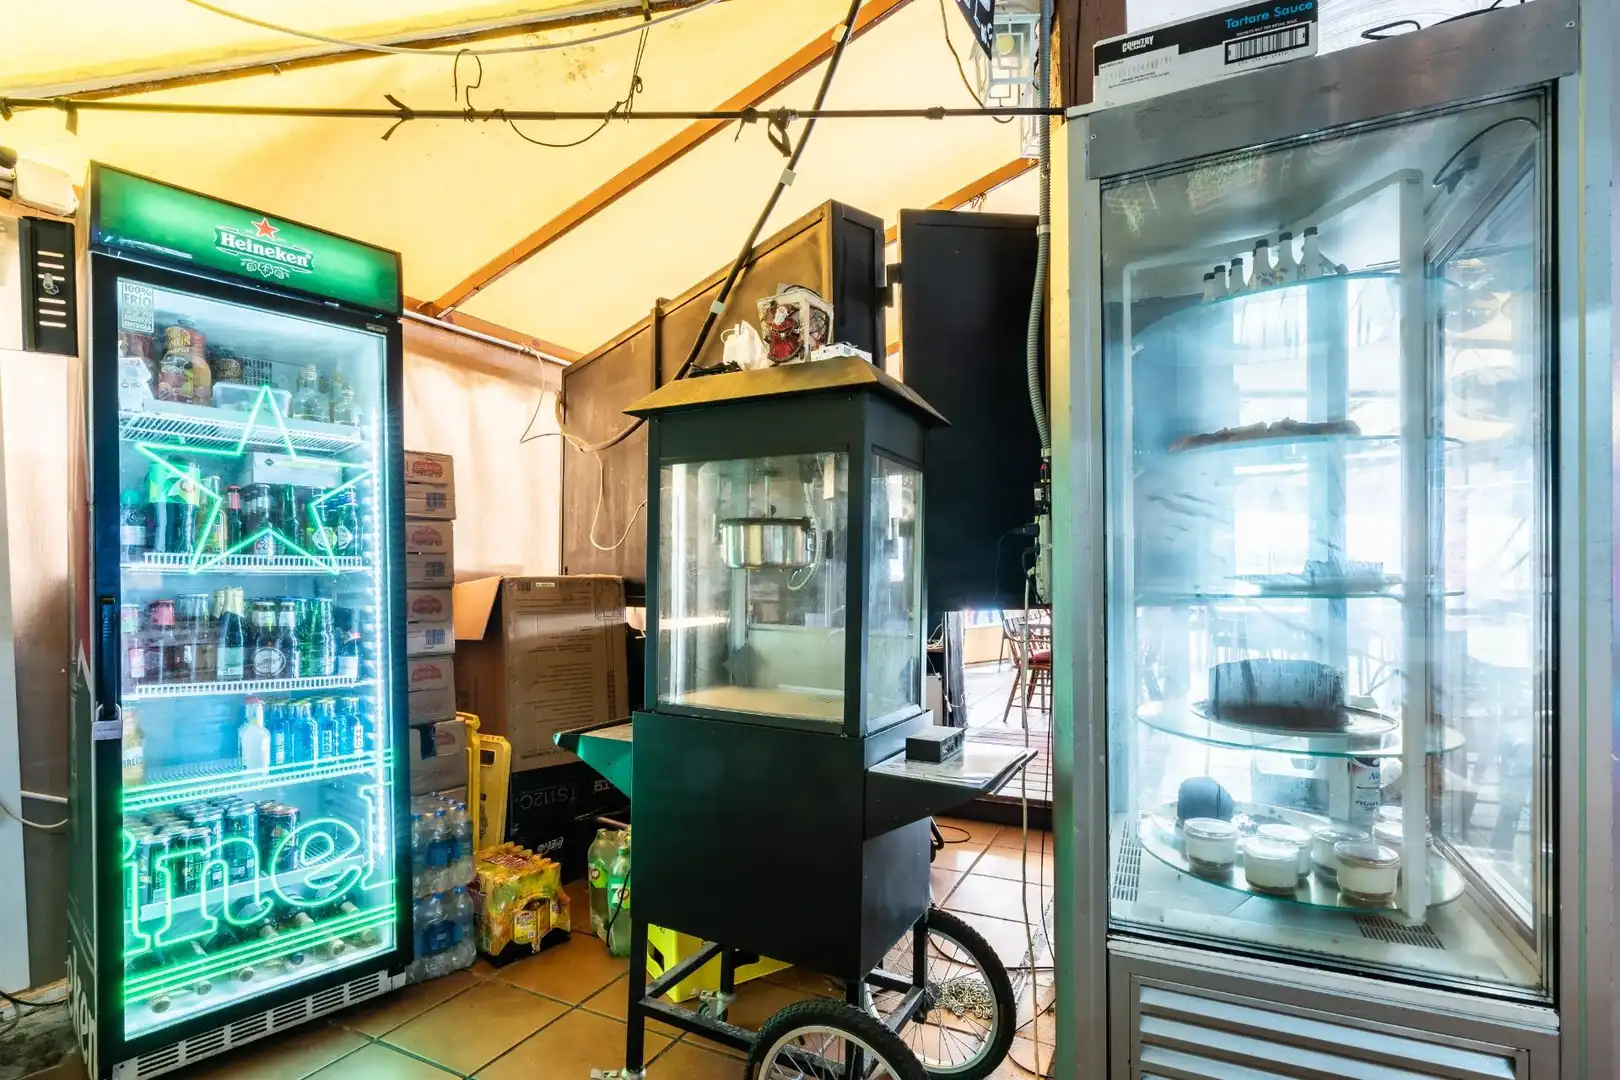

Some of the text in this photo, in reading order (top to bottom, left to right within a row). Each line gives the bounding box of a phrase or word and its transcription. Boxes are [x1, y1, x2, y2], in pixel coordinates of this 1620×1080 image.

[1225, 1, 1313, 29] Tartare Sauce
[1122, 35, 1154, 53] COUNTRY
[221, 232, 308, 267] Heineken
[520, 786, 578, 810] TS112C
